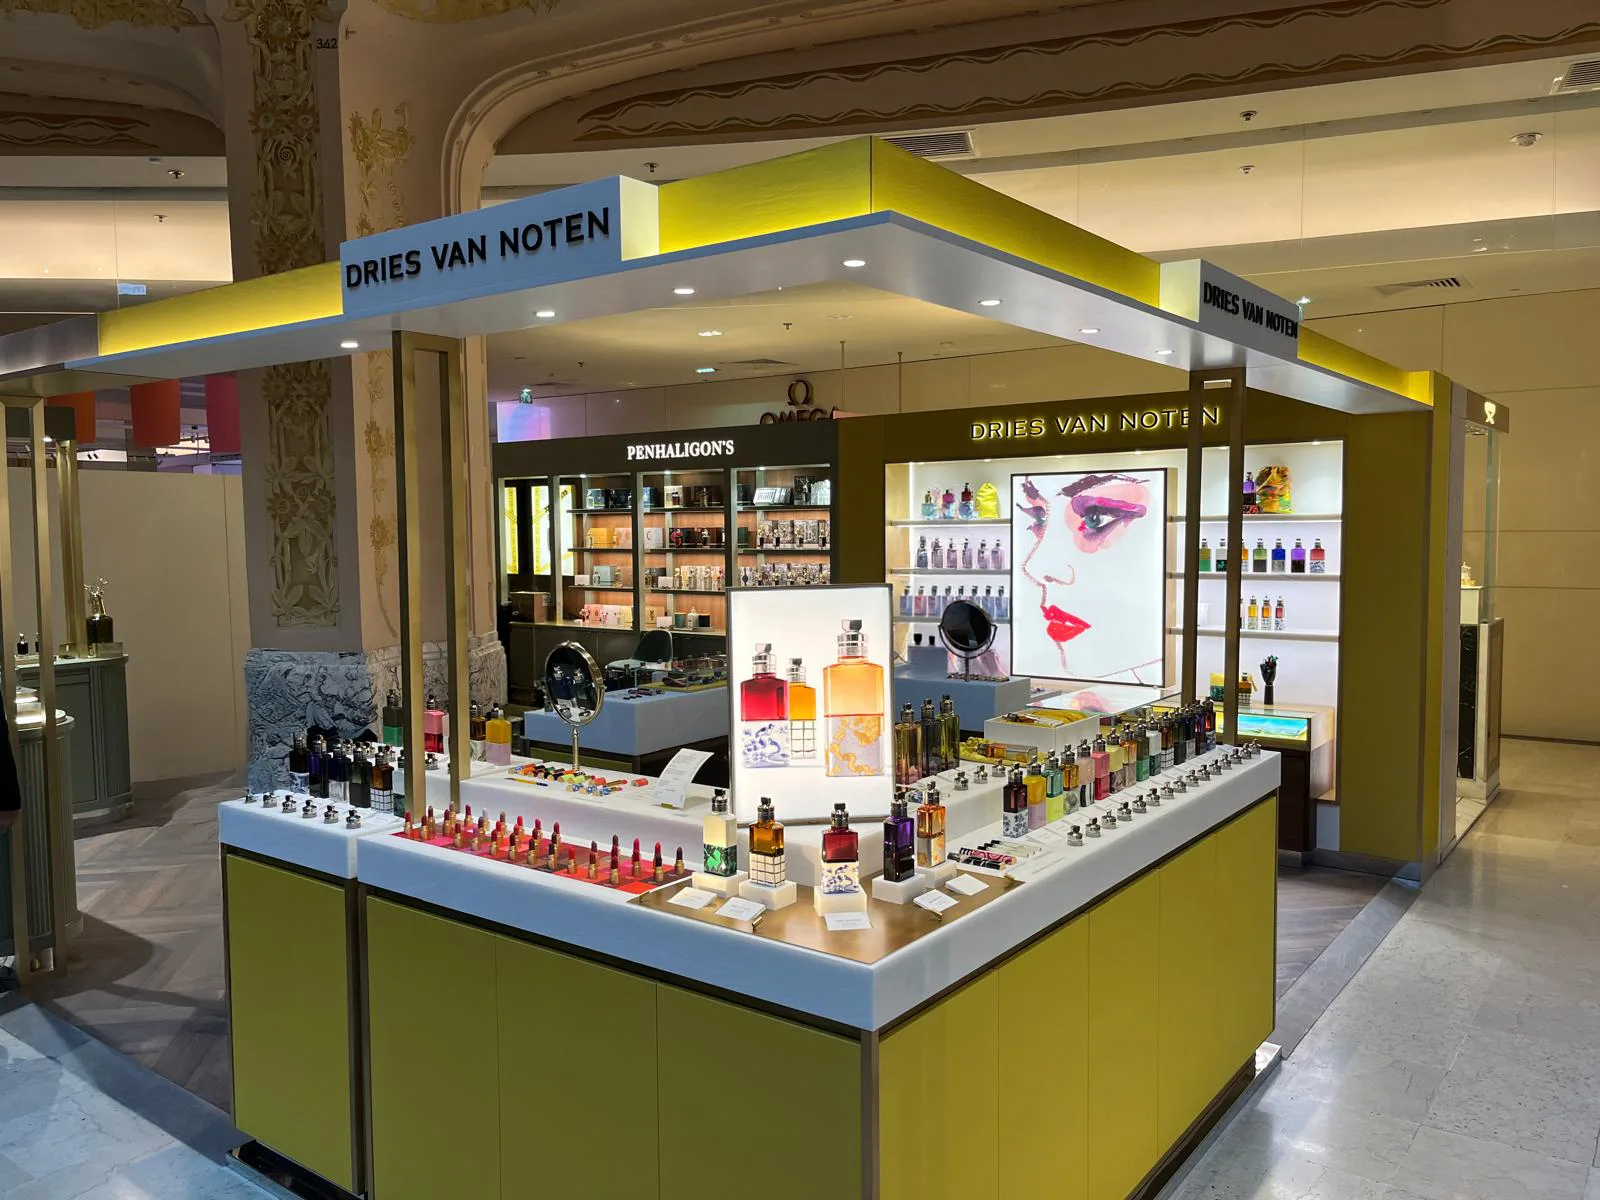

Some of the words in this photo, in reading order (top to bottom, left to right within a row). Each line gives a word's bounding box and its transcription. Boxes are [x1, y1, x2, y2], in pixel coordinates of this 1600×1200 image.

[316, 38, 338, 49] 342
[346, 250, 421, 288] DRIES
[431, 235, 486, 270] VAN
[500, 207, 609, 257] NOTEN
[1203, 281, 1240, 315] DRIES
[1242, 298, 1264, 326] VAN
[1265, 309, 1298, 339] NOTEN
[971, 418, 1046, 441] DRIES
[1056, 414, 1108, 434] VAN
[1120, 407, 1220, 431] NOTEN
[626, 439, 735, 460] PENHALIGON'S
